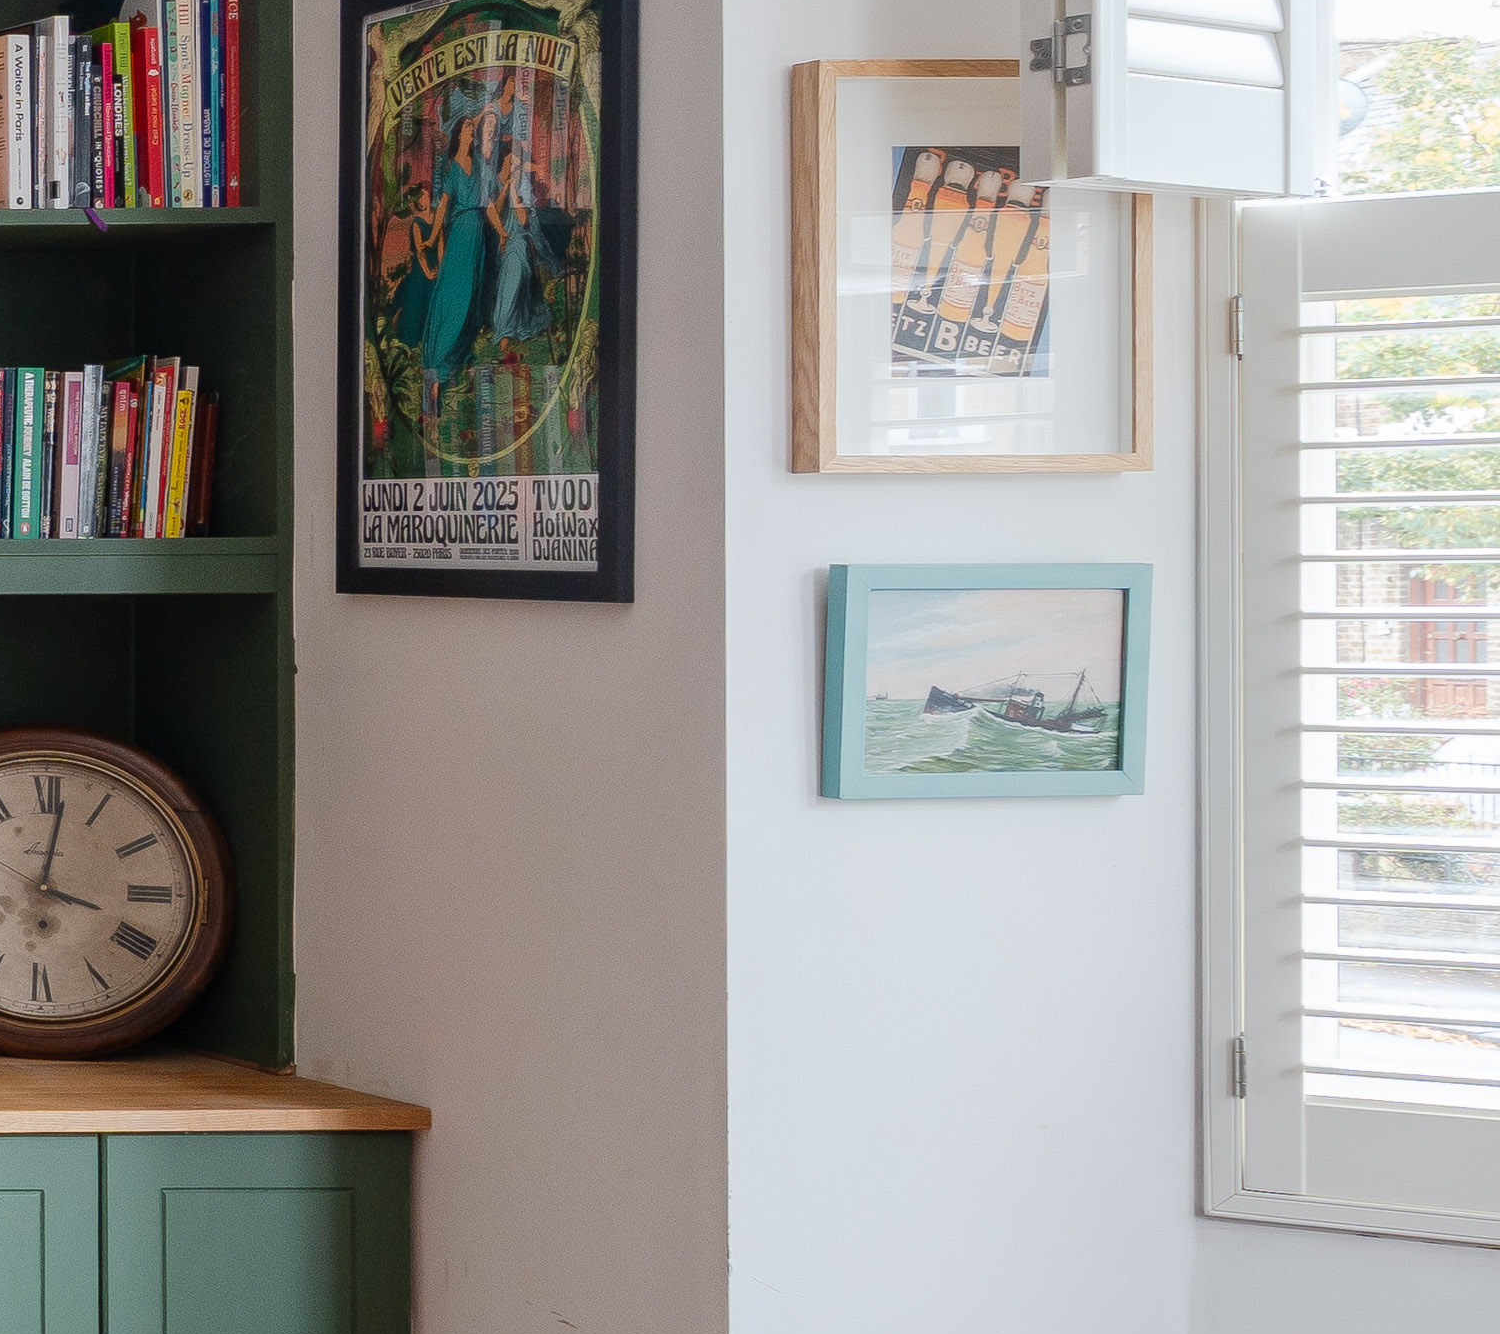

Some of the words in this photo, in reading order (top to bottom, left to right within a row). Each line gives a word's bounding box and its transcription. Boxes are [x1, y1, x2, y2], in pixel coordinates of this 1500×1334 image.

[14, 43, 23, 53] A
[15, 56, 24, 96] Waiter
[390, 51, 447, 107] VERTE
[453, 36, 488, 68] EST
[494, 33, 518, 62] LA
[524, 35, 573, 72] NUIT
[15, 99, 24, 109] in
[114, 83, 123, 137] LONDRES
[15, 113, 24, 142] Paris
[964, 335, 1022, 365] BEER
[363, 483, 408, 512] LUNDI
[413, 483, 424, 511] 2
[429, 482, 467, 511] JUIN
[472, 481, 519, 511] 2025
[532, 479, 592, 510] TVOD
[364, 515, 383, 543] LA
[387, 514, 519, 546] MAROQUINERIE
[432, 548, 452, 559] PARIS
[533, 539, 598, 561] DJANINA
